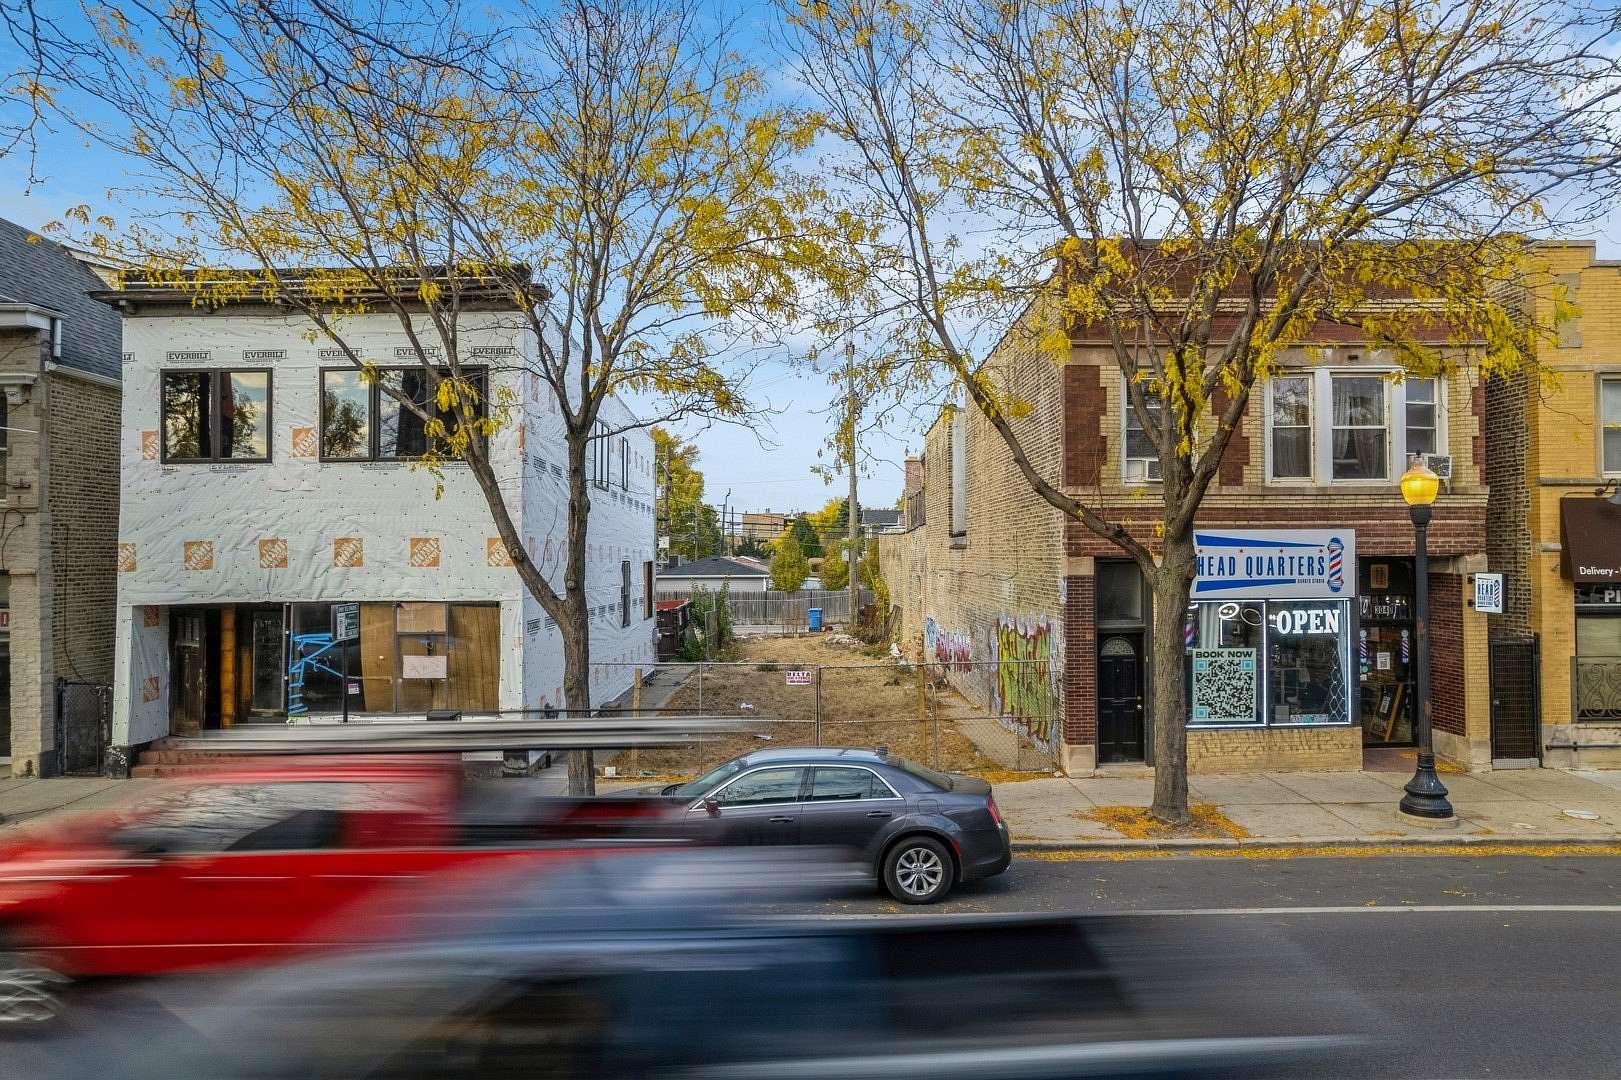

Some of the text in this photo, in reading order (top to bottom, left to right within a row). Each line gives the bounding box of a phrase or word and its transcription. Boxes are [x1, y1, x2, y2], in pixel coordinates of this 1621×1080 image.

[168, 352, 209, 361] EVERBILT
[244, 351, 285, 360] EVERBILT
[396, 348, 436, 356] EVEILT
[1197, 555, 1325, 578] HEAD QUARTERS
[1579, 566, 1613, 577] Delivery
[1277, 609, 1340, 635] OPEN
[1195, 651, 1253, 659] BOOK NOW
